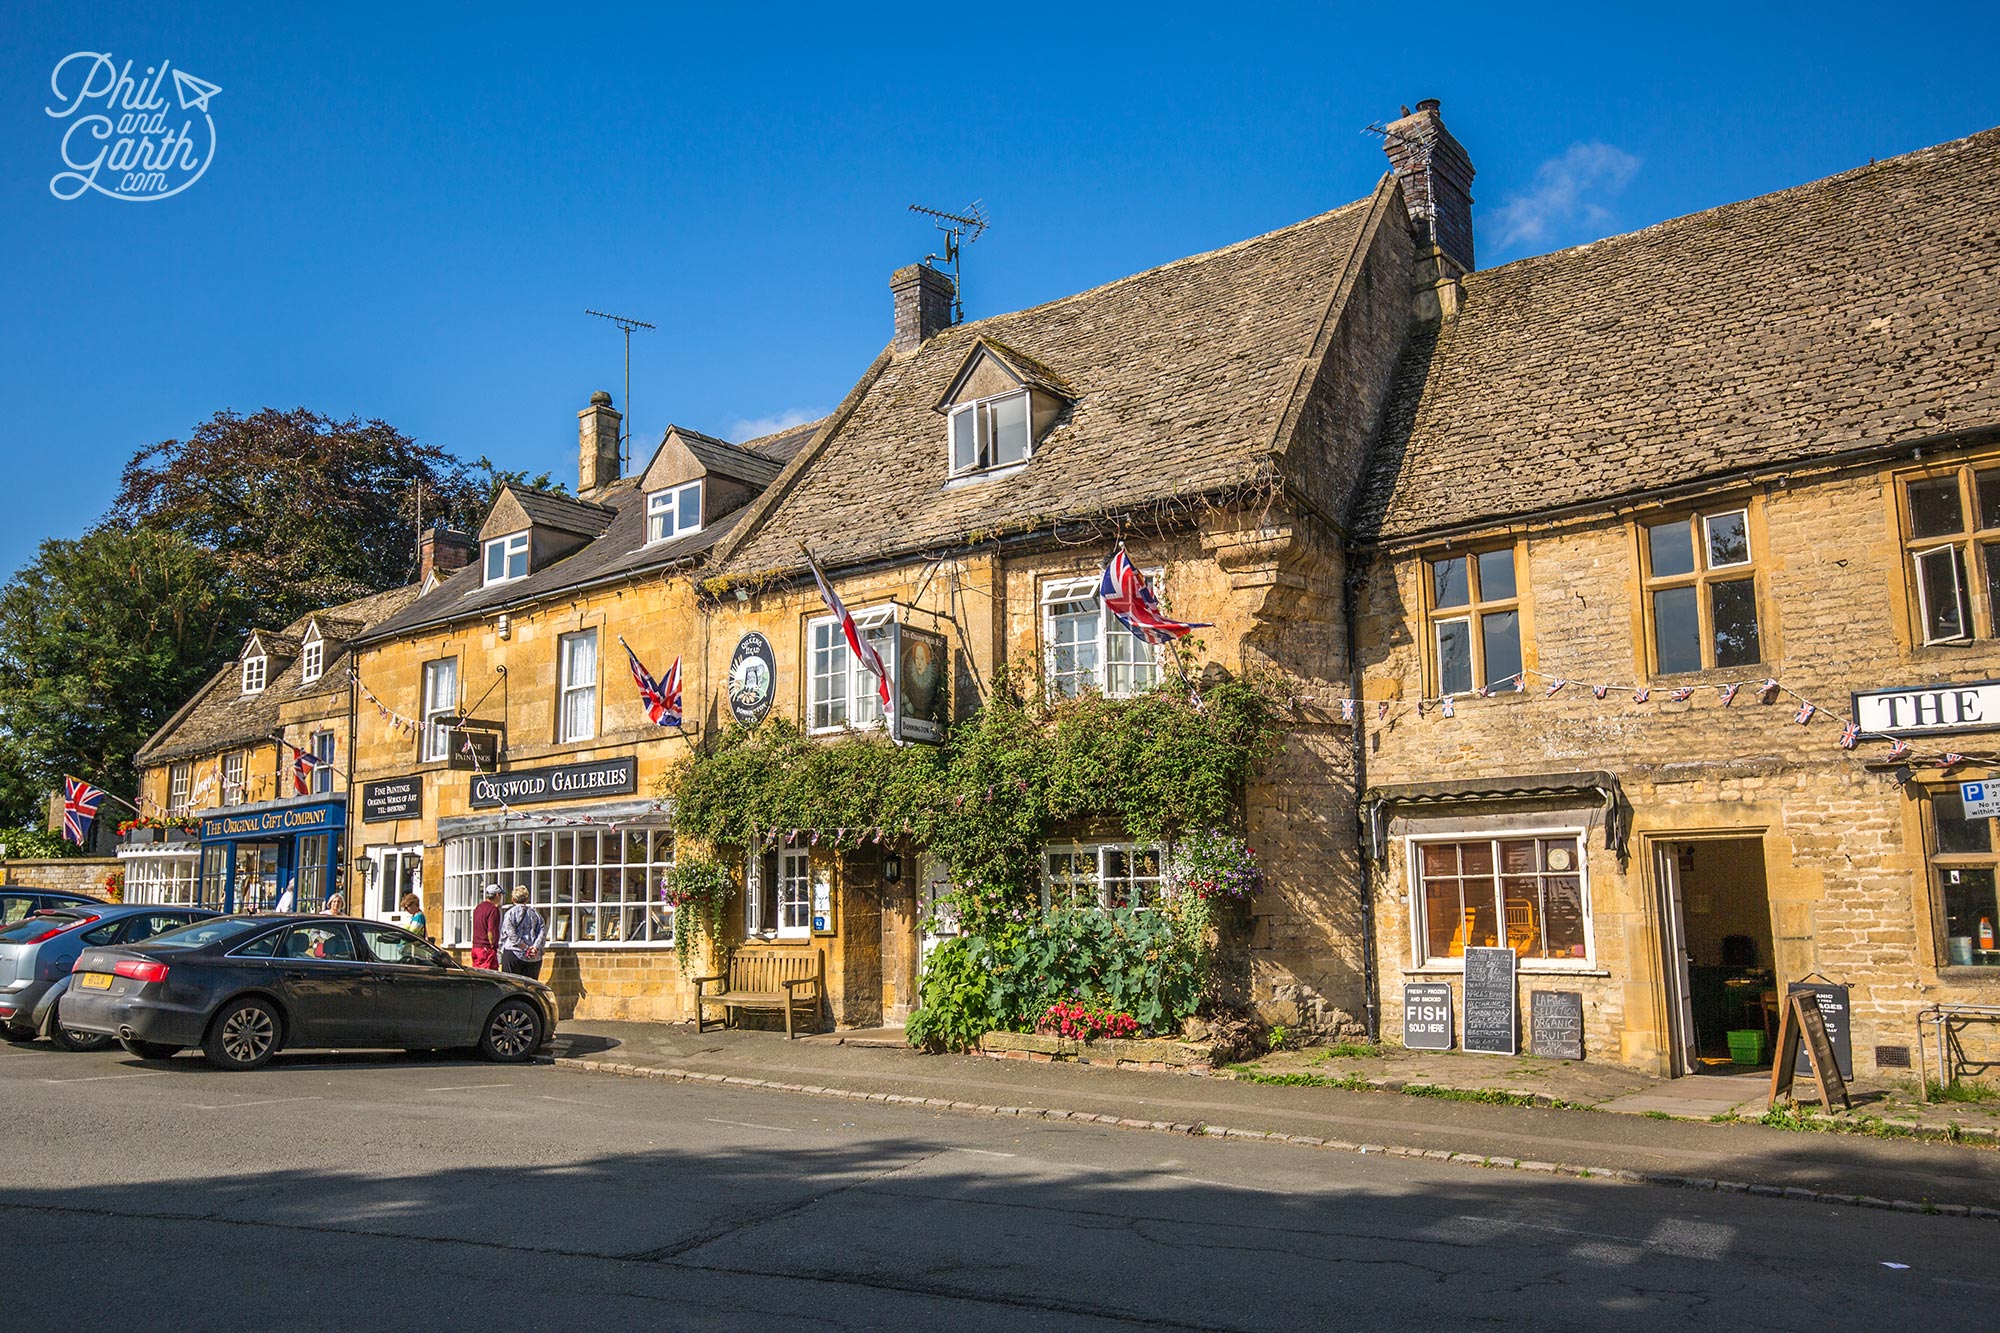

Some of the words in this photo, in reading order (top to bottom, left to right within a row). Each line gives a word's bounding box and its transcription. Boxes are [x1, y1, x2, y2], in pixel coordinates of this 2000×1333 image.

[1878, 689, 1983, 728] THE
[455, 752, 491, 762] PAINTNGS
[476, 777, 546, 800] COTSWOLD
[551, 768, 627, 792] GALLERIES
[374, 787, 386, 796] FINE
[205, 820, 222, 836] THE
[223, 818, 260, 834] ORIGINAL
[261, 813, 283, 829] GIFT
[284, 809, 327, 827] COMPANY
[1407, 1006, 1447, 1021] FISH
[1409, 1023, 1426, 1033] SOLD
[1427, 1023, 1445, 1033] HERE
[1534, 1018, 1575, 1029] ORGANIC
[1535, 1030, 1571, 1041] FRUIT
